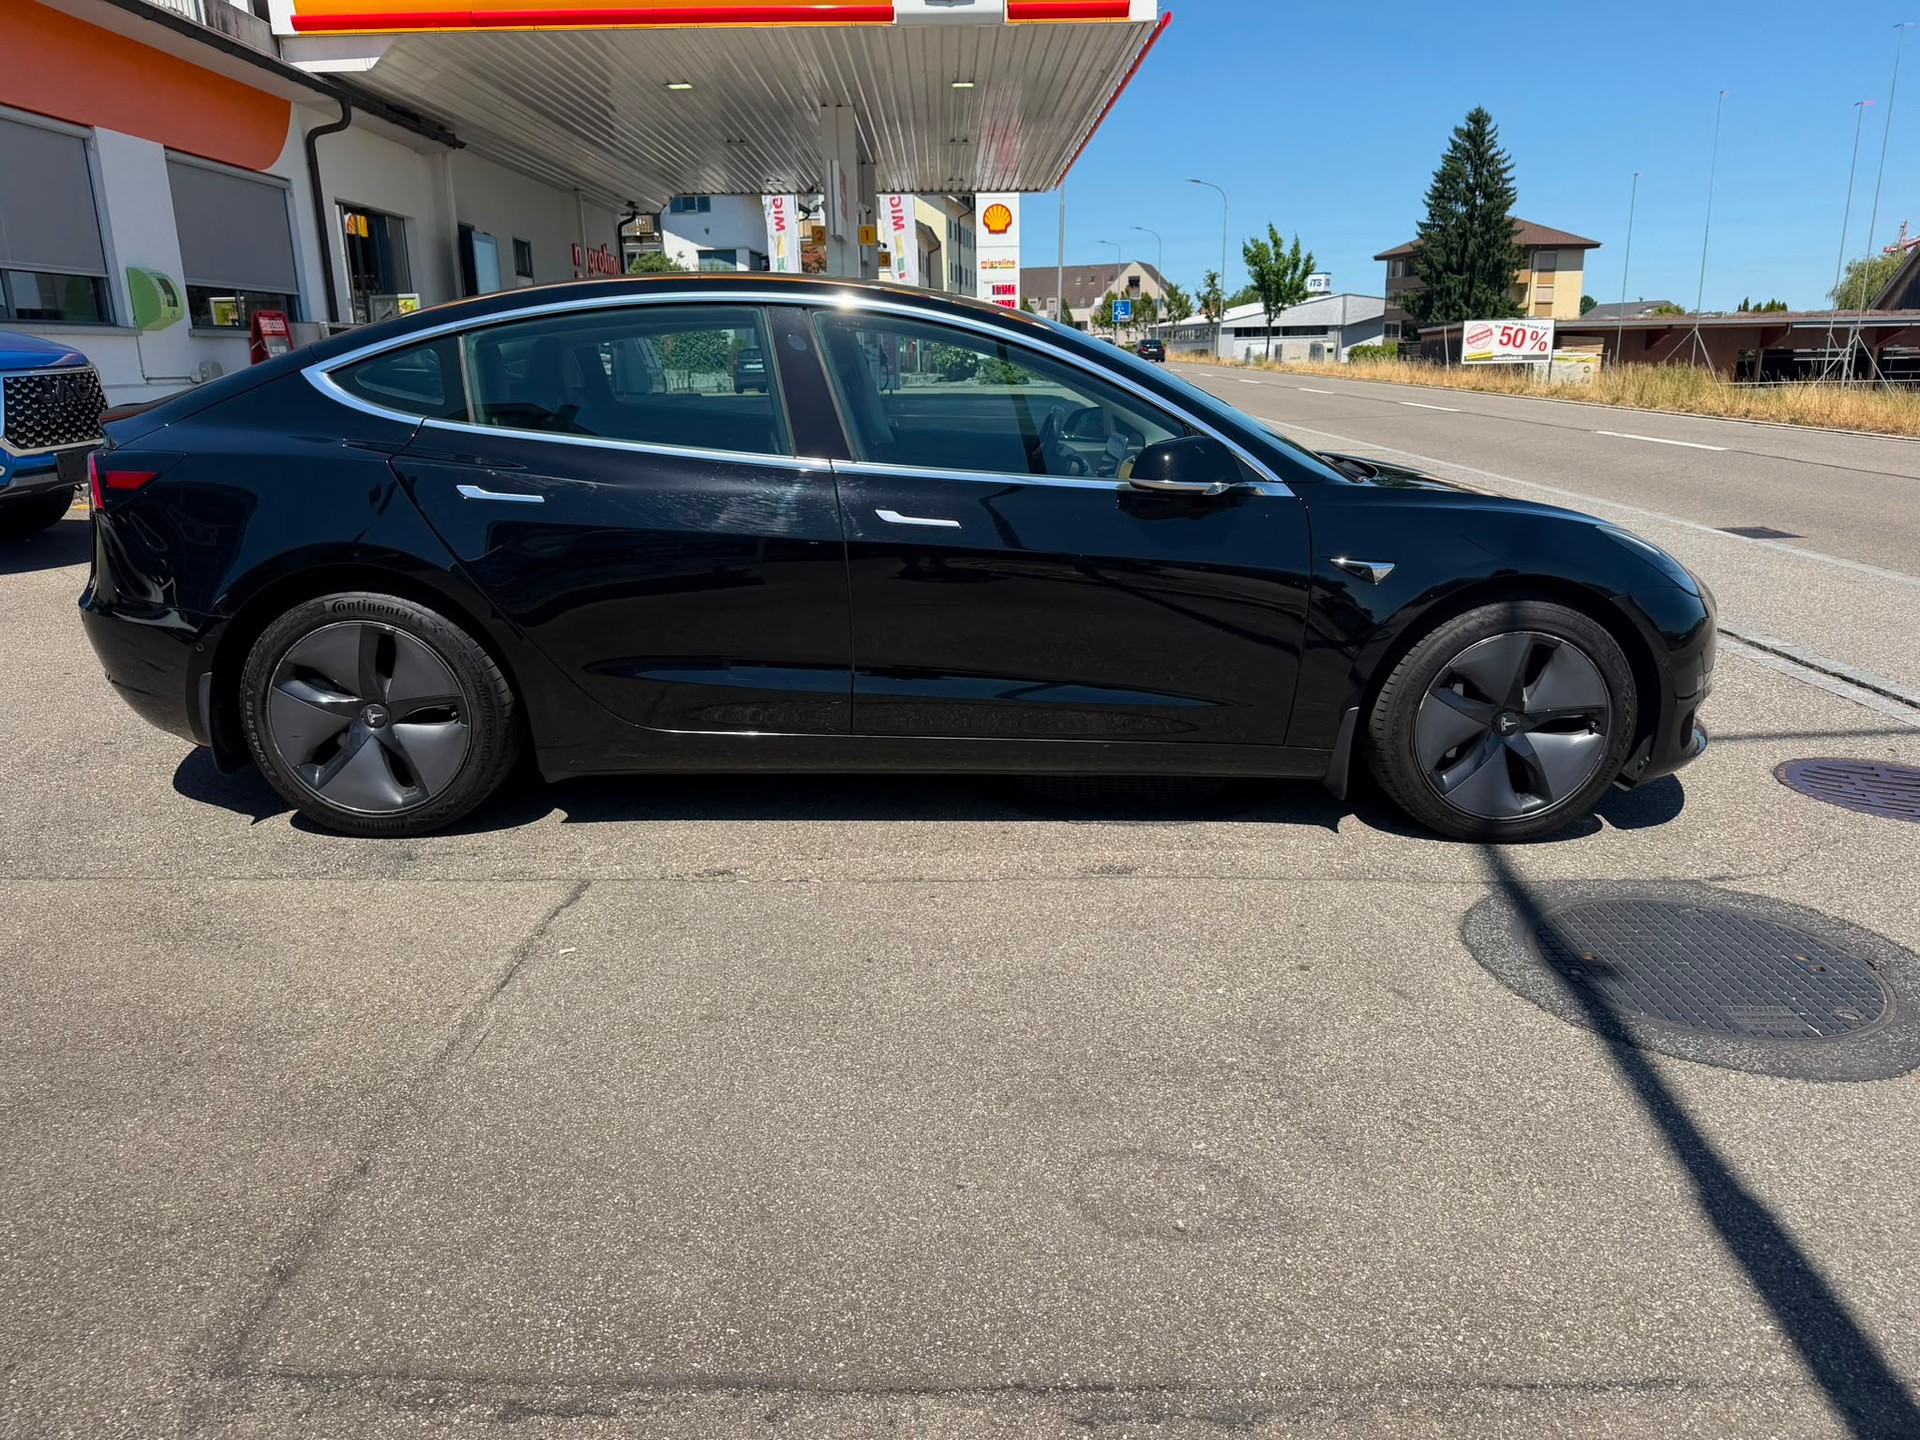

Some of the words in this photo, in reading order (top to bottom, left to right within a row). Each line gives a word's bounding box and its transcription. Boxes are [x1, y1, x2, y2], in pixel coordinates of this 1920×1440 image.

[815, 230, 824, 241] 2
[864, 229, 870, 241] 1
[882, 254, 889, 264] 3
[332, 599, 415, 621] Continental
